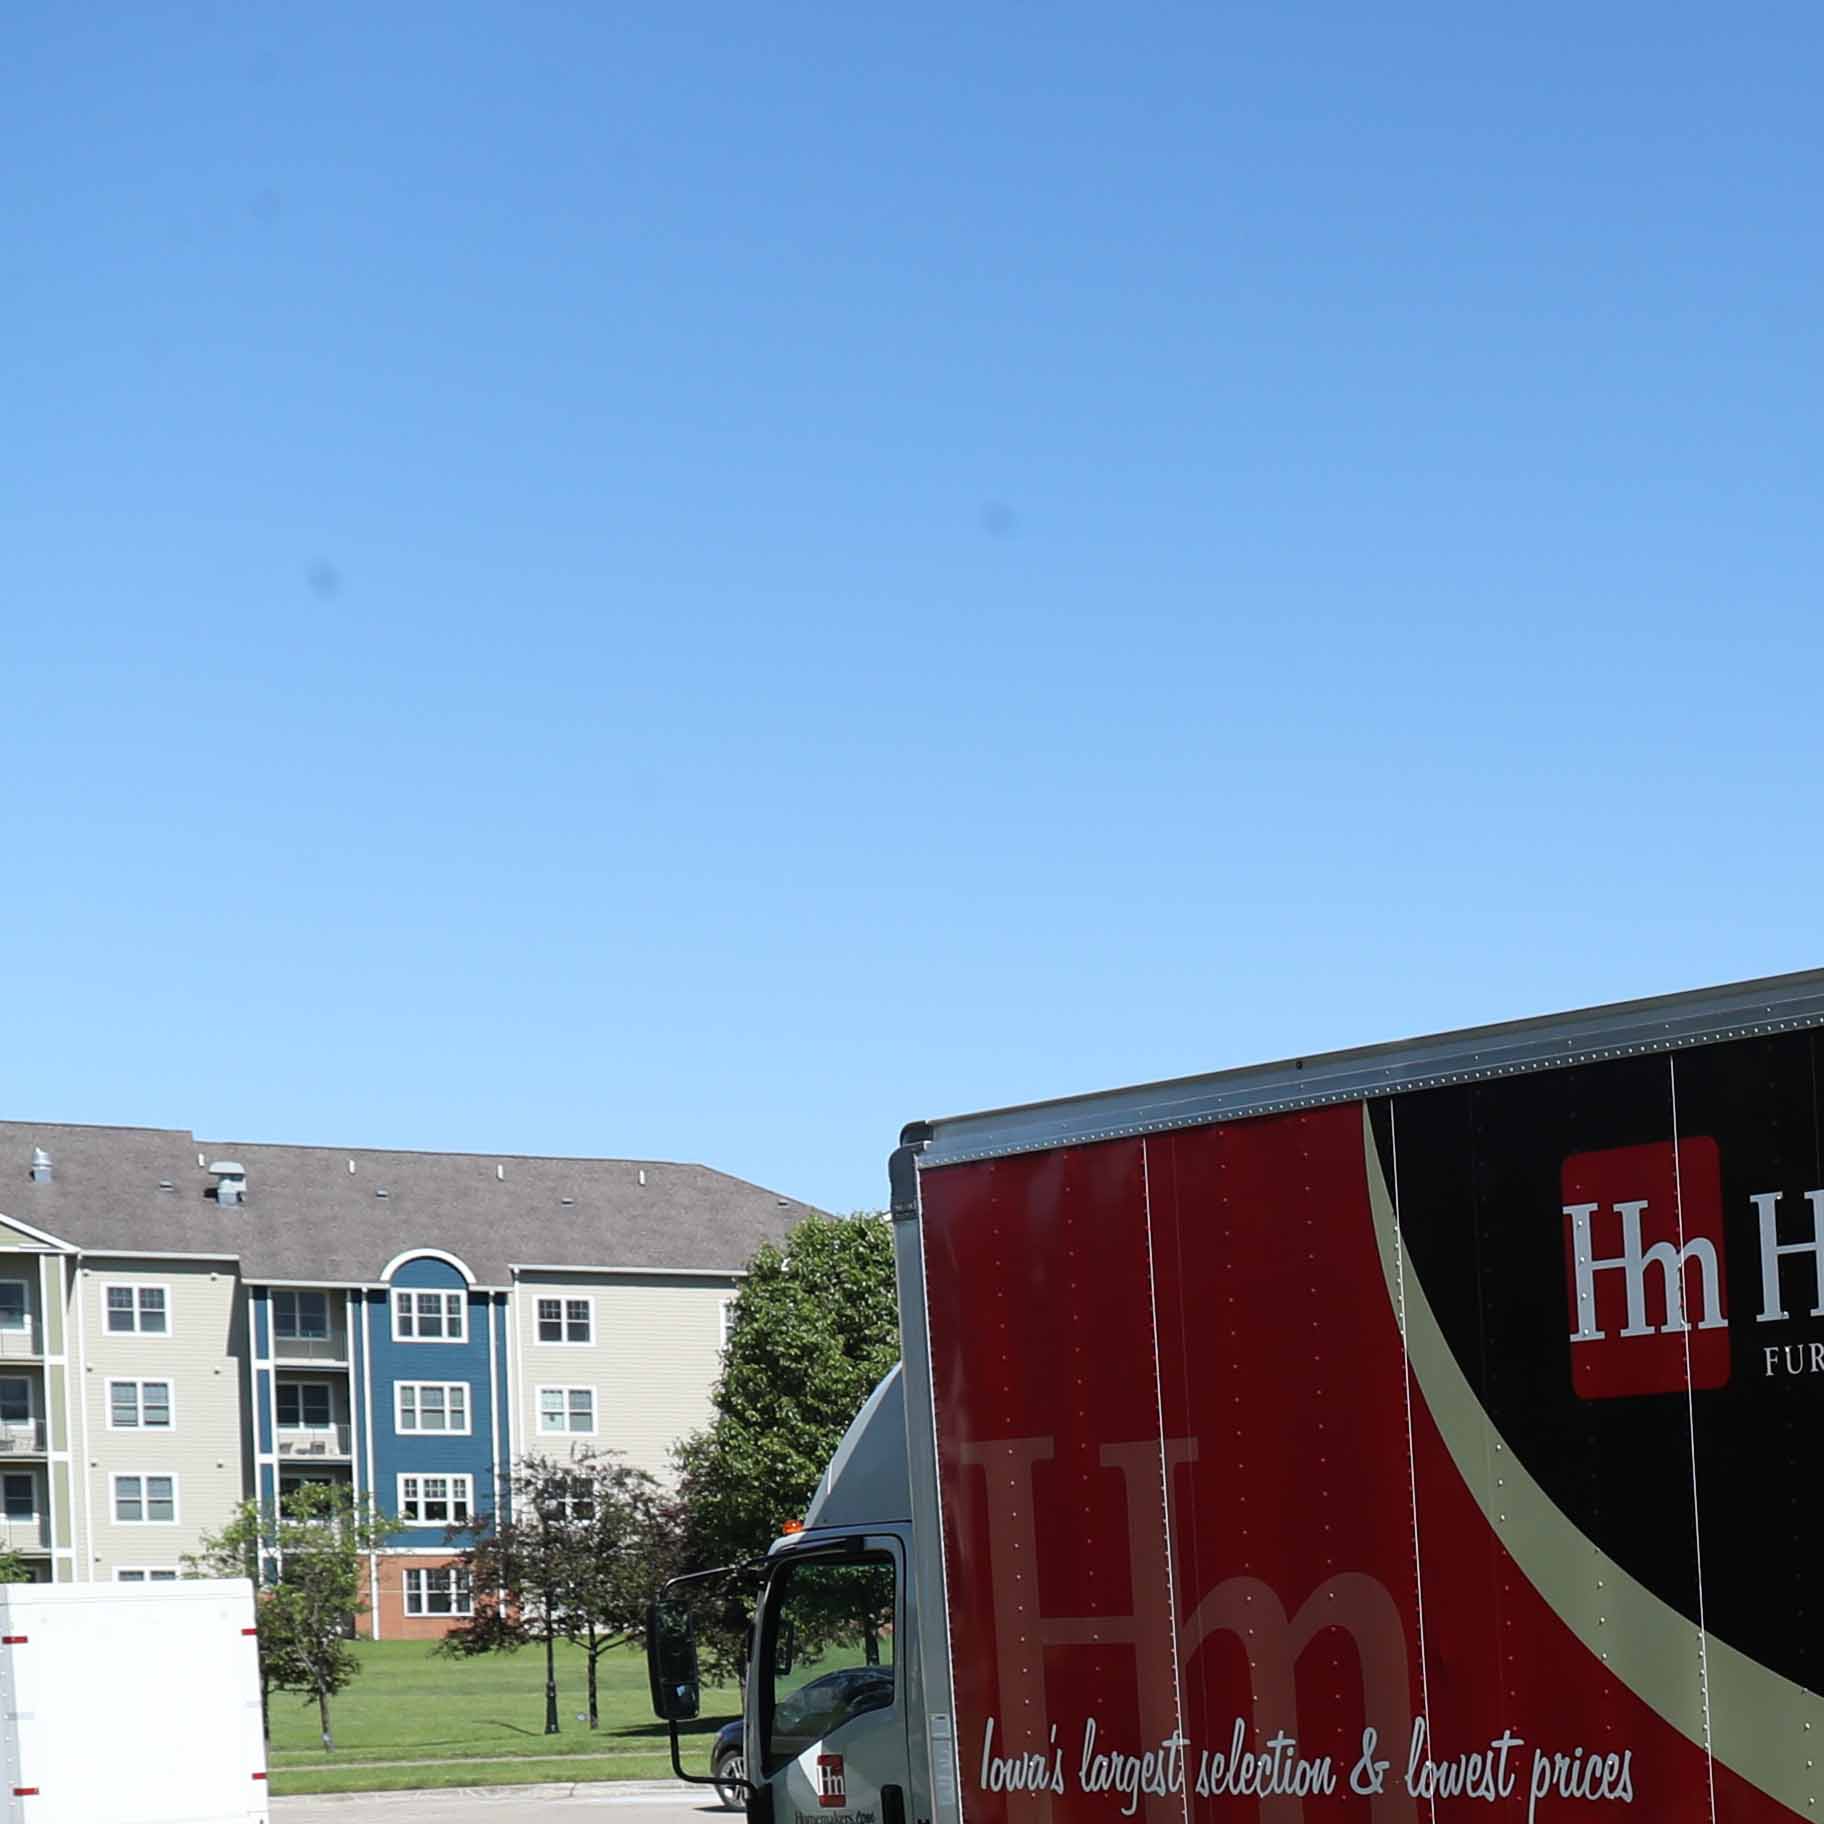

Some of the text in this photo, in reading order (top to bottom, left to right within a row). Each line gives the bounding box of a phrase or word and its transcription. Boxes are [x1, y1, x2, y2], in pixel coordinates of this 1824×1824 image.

[1563, 1200, 1728, 1342] Hm
[816, 1765, 846, 1796] Hm
[979, 1717, 1065, 1795] Iowa's
[1078, 1717, 1191, 1817] largest
[1195, 1717, 1336, 1799] selection
[1349, 1726, 1391, 1796] &
[1404, 1715, 1525, 1803] lowest
